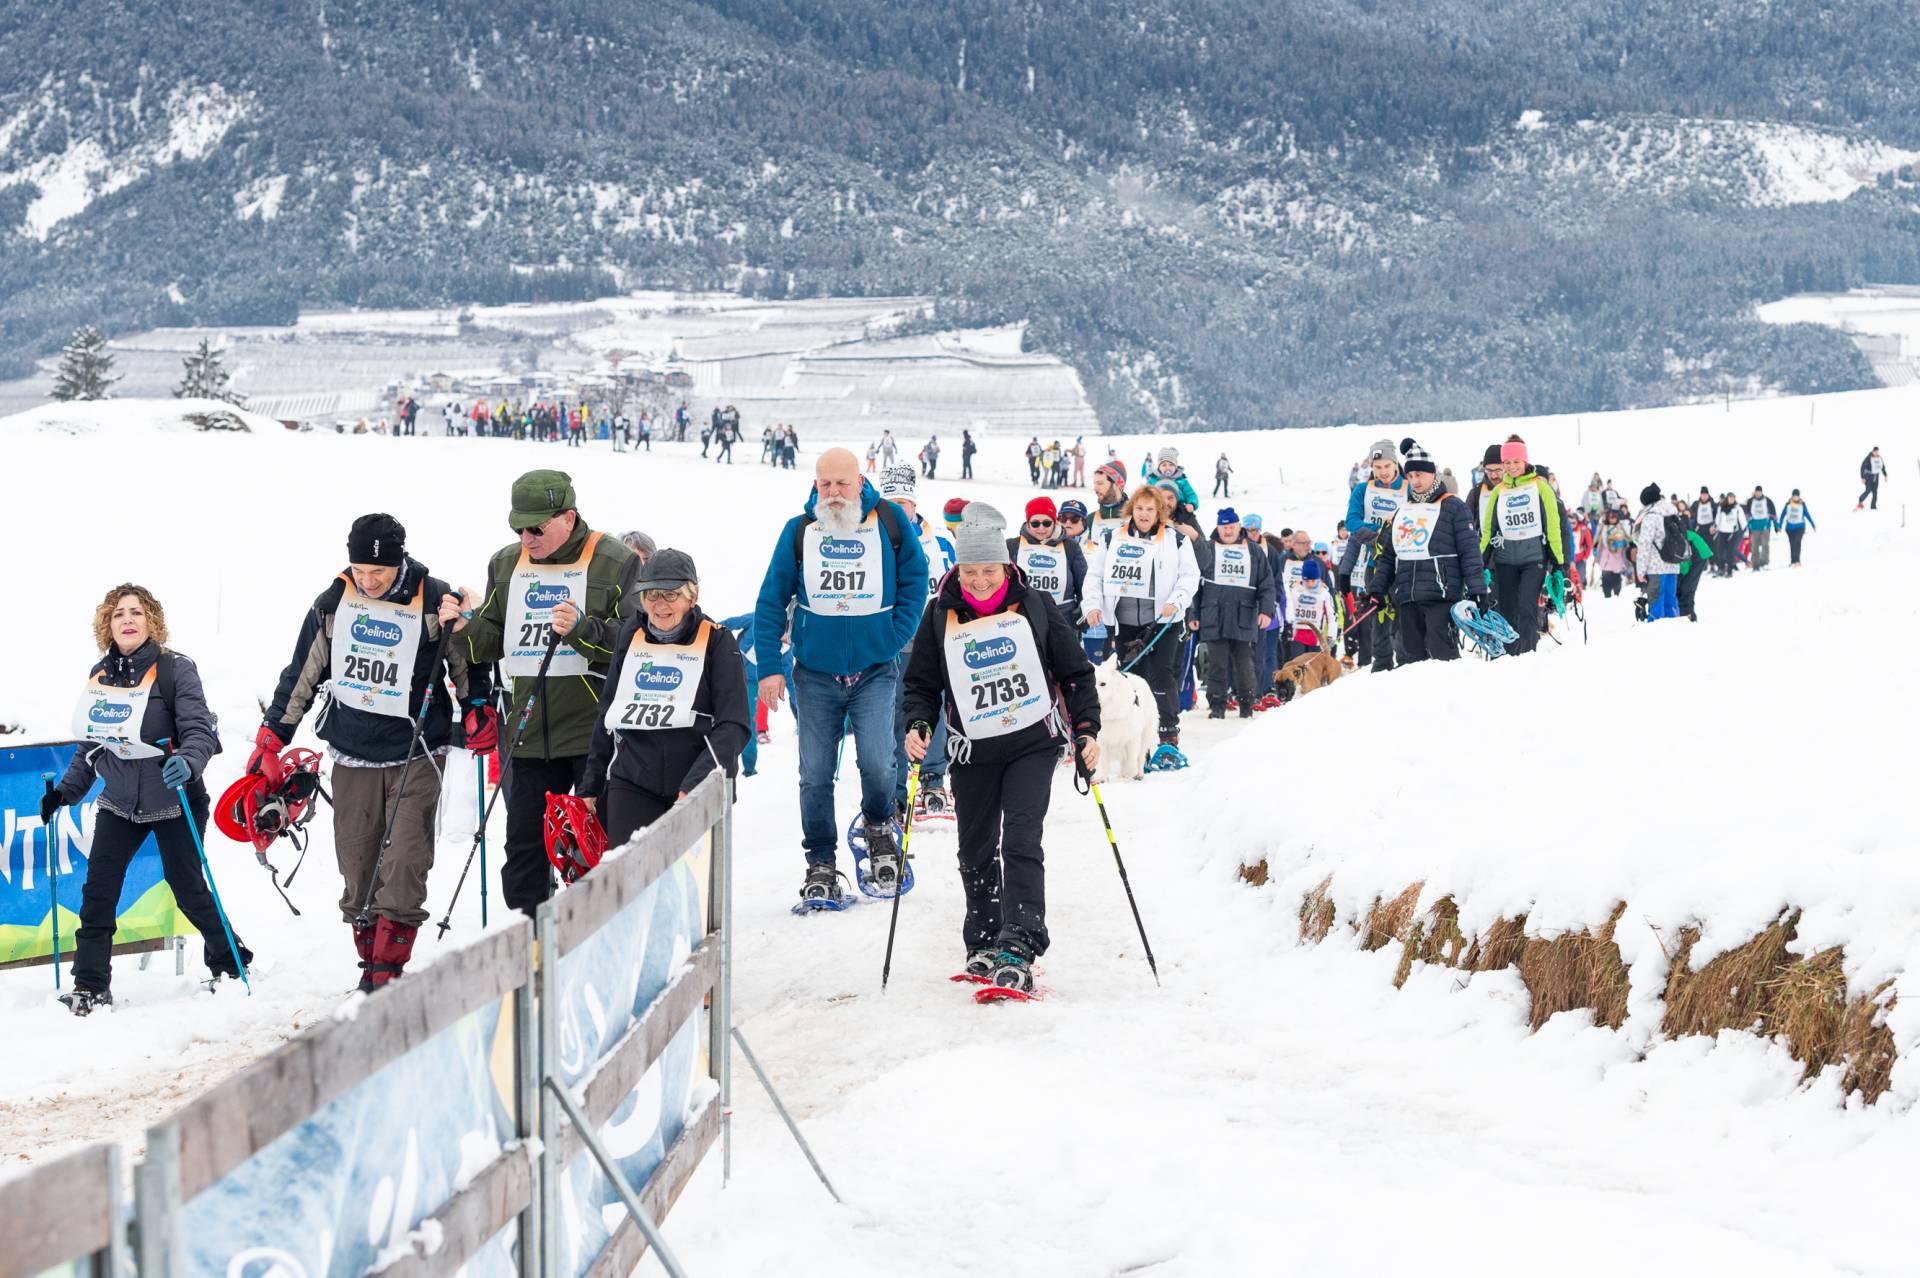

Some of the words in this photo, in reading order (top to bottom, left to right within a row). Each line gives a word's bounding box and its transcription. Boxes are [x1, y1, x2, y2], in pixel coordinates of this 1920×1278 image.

[1505, 511, 1535, 526] 3038
[821, 543, 863, 553] Melinda
[1111, 565, 1142, 580] 2644
[1221, 564, 1245, 575] 3344
[820, 570, 866, 590] 2617
[527, 589, 569, 602] Melinda
[1295, 609, 1317, 619] 3309
[353, 623, 400, 640] Melinda
[519, 623, 569, 647] 273
[966, 642, 1014, 663] Melinda
[344, 655, 399, 687] 2504
[637, 670, 680, 684] Melinda
[971, 673, 1030, 710] 2733
[91, 706, 130, 718] Melinda
[621, 703, 675, 727] 2732
